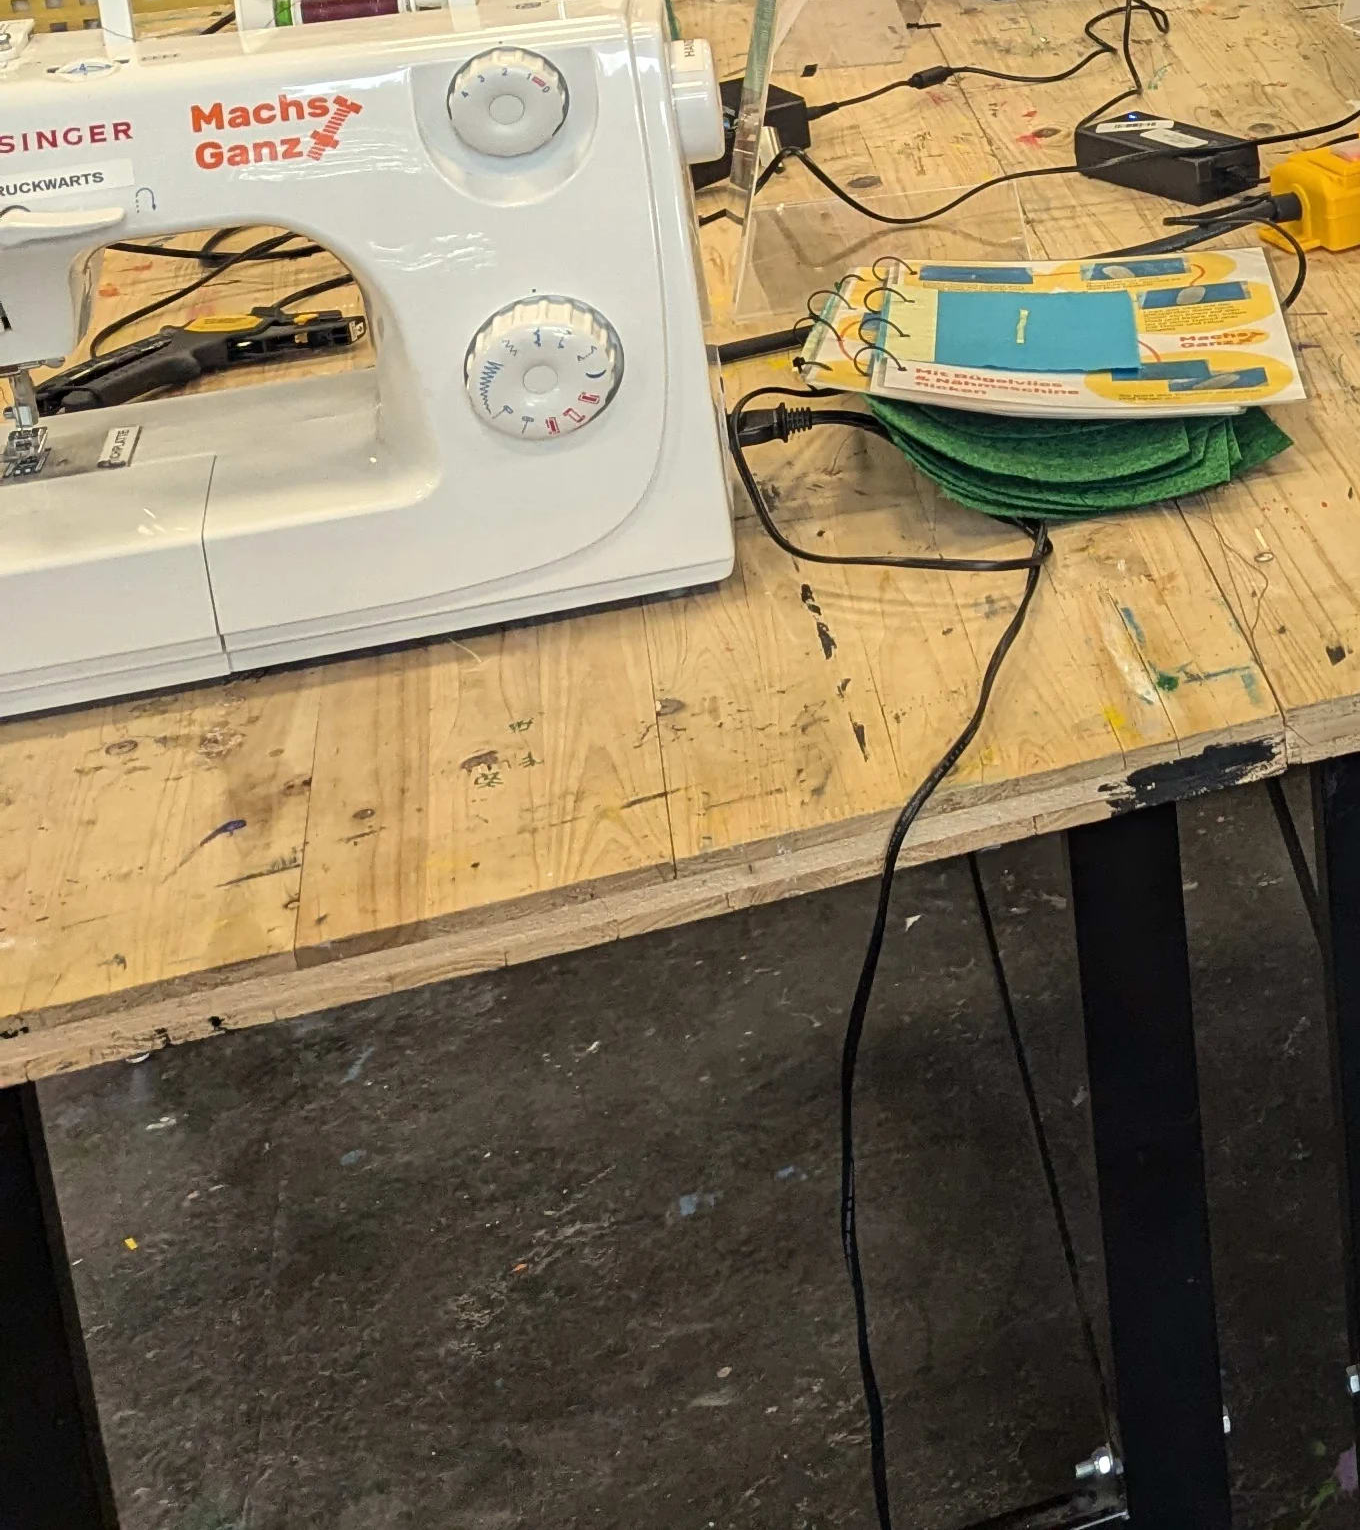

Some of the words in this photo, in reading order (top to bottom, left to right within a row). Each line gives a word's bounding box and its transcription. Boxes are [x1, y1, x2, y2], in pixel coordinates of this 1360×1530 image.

[190, 93, 331, 133] Machs
[0, 121, 133, 154] SINGER
[194, 136, 303, 170] Ganz
